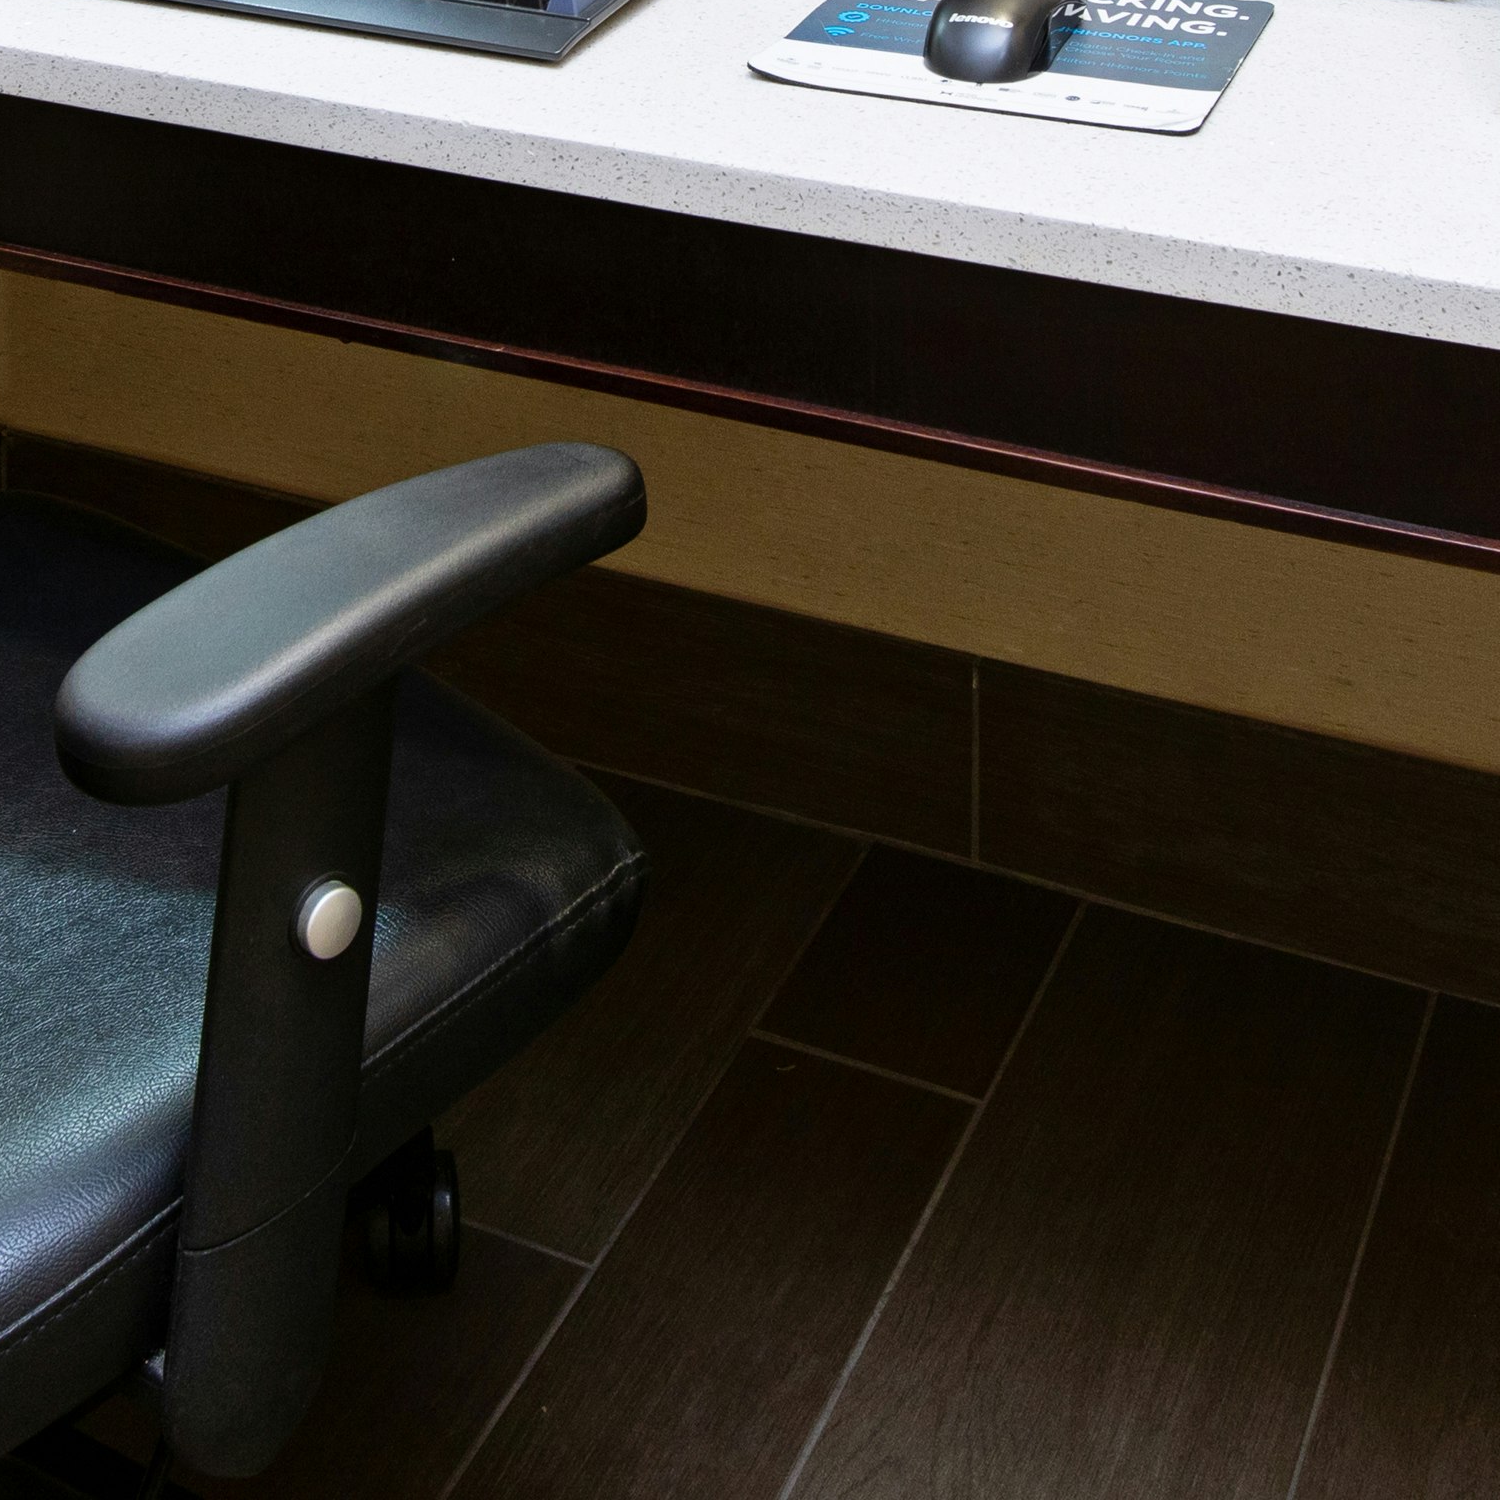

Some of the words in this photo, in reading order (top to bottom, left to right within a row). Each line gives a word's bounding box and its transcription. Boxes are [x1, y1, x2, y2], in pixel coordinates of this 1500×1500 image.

[856, 3, 933, 17] DOWNLO
[949, 13, 1013, 29] lenovo
[860, 32, 890, 40] Free
[1064, 47, 1115, 57] Choose
[1121, 53, 1149, 61] Your
[1155, 56, 1195, 67] Room
[1069, 41, 1112, 52] Digital
[1179, 53, 1205, 62] and
[1056, 56, 1097, 67] Hilton
